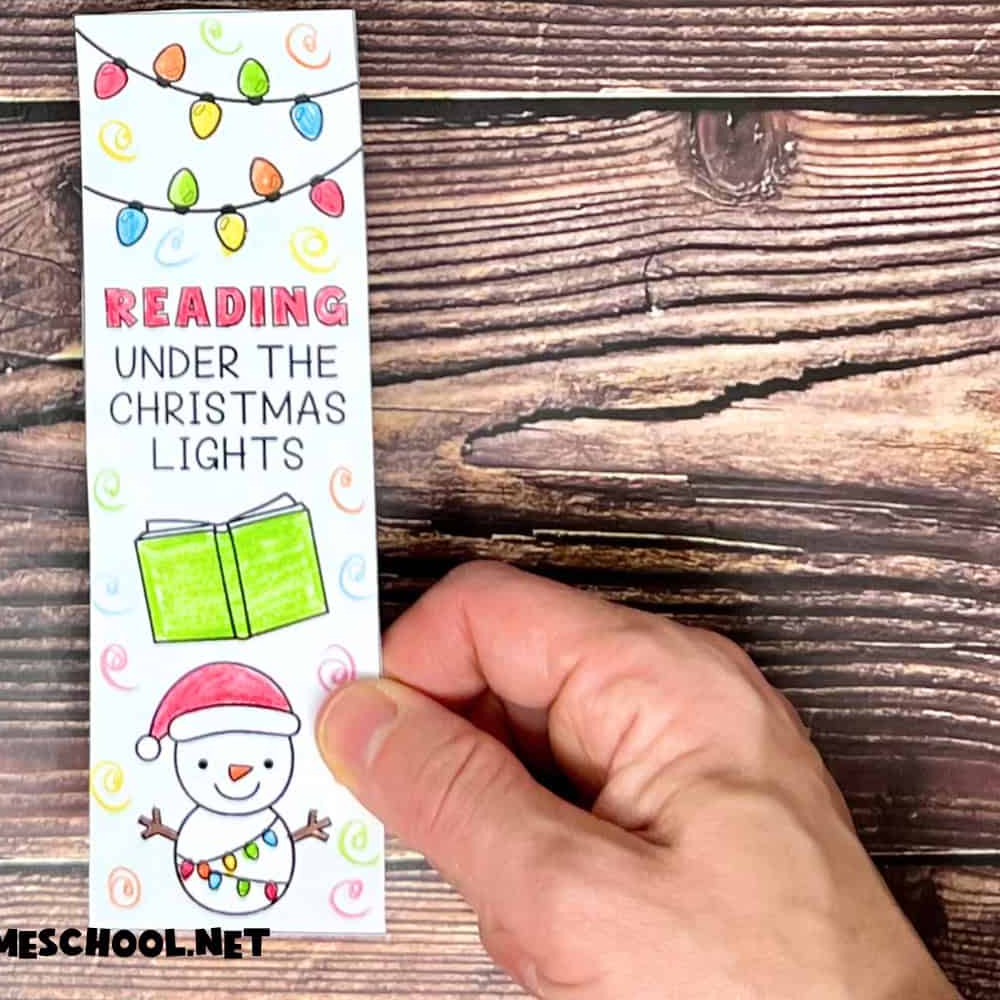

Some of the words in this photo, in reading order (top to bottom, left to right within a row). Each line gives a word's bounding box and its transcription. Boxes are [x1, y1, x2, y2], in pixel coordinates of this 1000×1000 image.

[103, 284, 350, 329] READING
[114, 345, 240, 380] UNDER
[256, 344, 339, 380] THE
[108, 391, 347, 426] CHRISTMAS
[151, 436, 305, 471] LIGHTS
